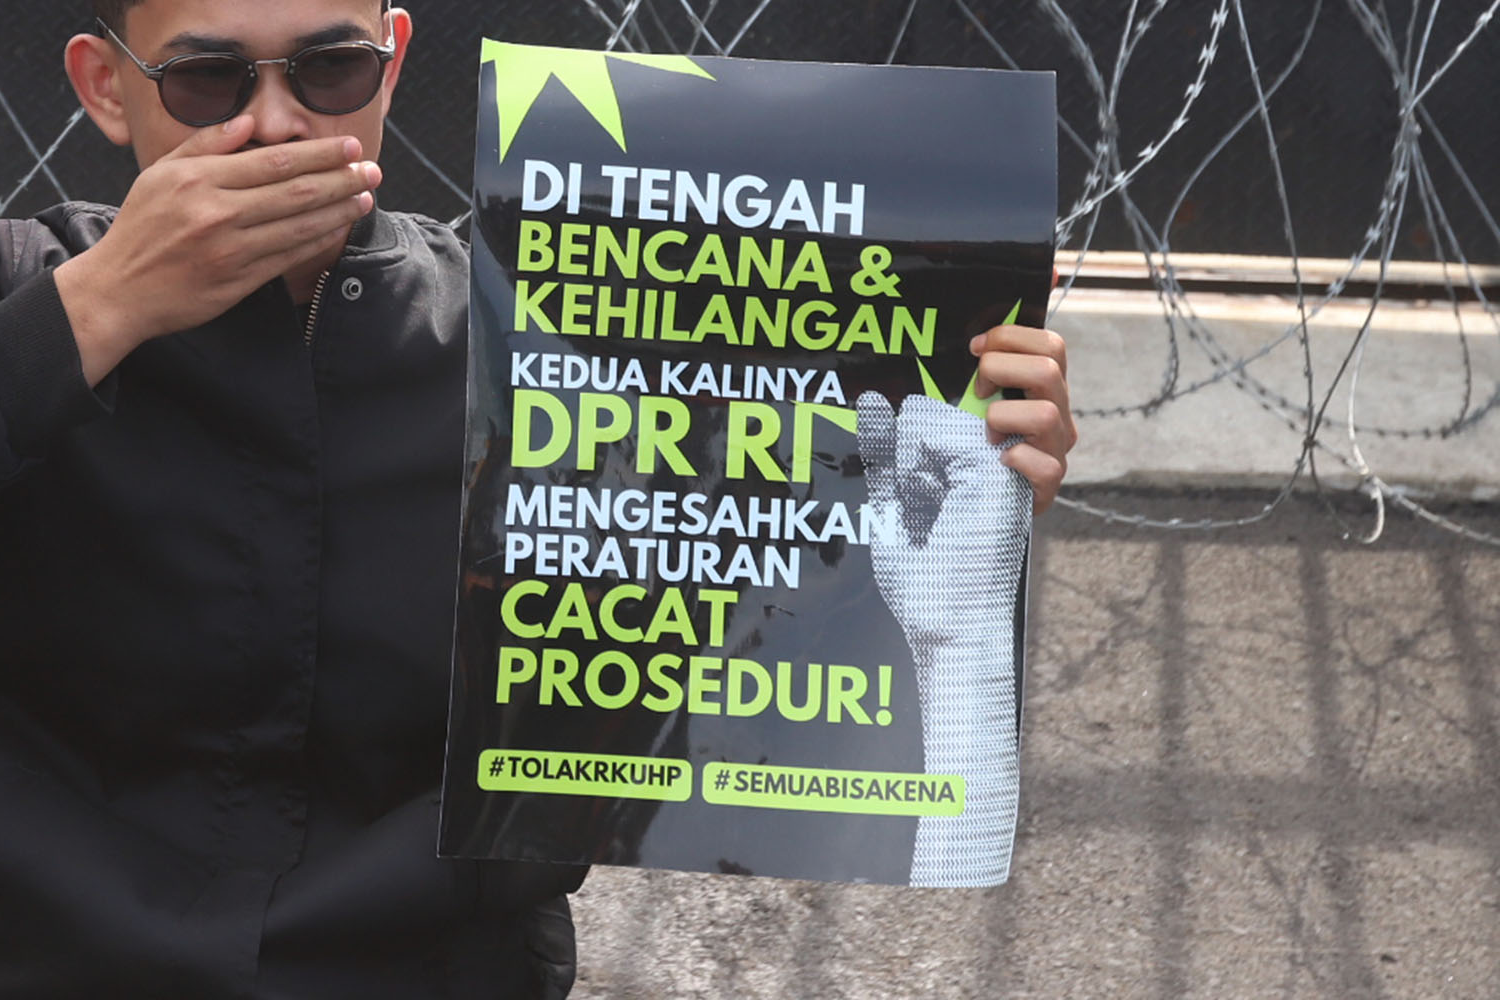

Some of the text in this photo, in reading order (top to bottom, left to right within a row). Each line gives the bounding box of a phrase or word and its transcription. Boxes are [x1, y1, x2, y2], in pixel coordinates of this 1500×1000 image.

[521, 159, 865, 235] DI TENGAH
[517, 220, 902, 298] BENCANA &
[513, 280, 938, 357] KEHILANGAN
[510, 353, 847, 406] KEDUA KALINYA
[511, 389, 815, 484] DPR RI
[505, 485, 896, 546] MENGESAHKAN
[505, 533, 800, 589] PERATURAN
[501, 580, 738, 647] CACAT
[496, 647, 893, 727] PROSEDUR!
[489, 756, 956, 804] #TOLAKRKUHP #SEMUABISAKENA
